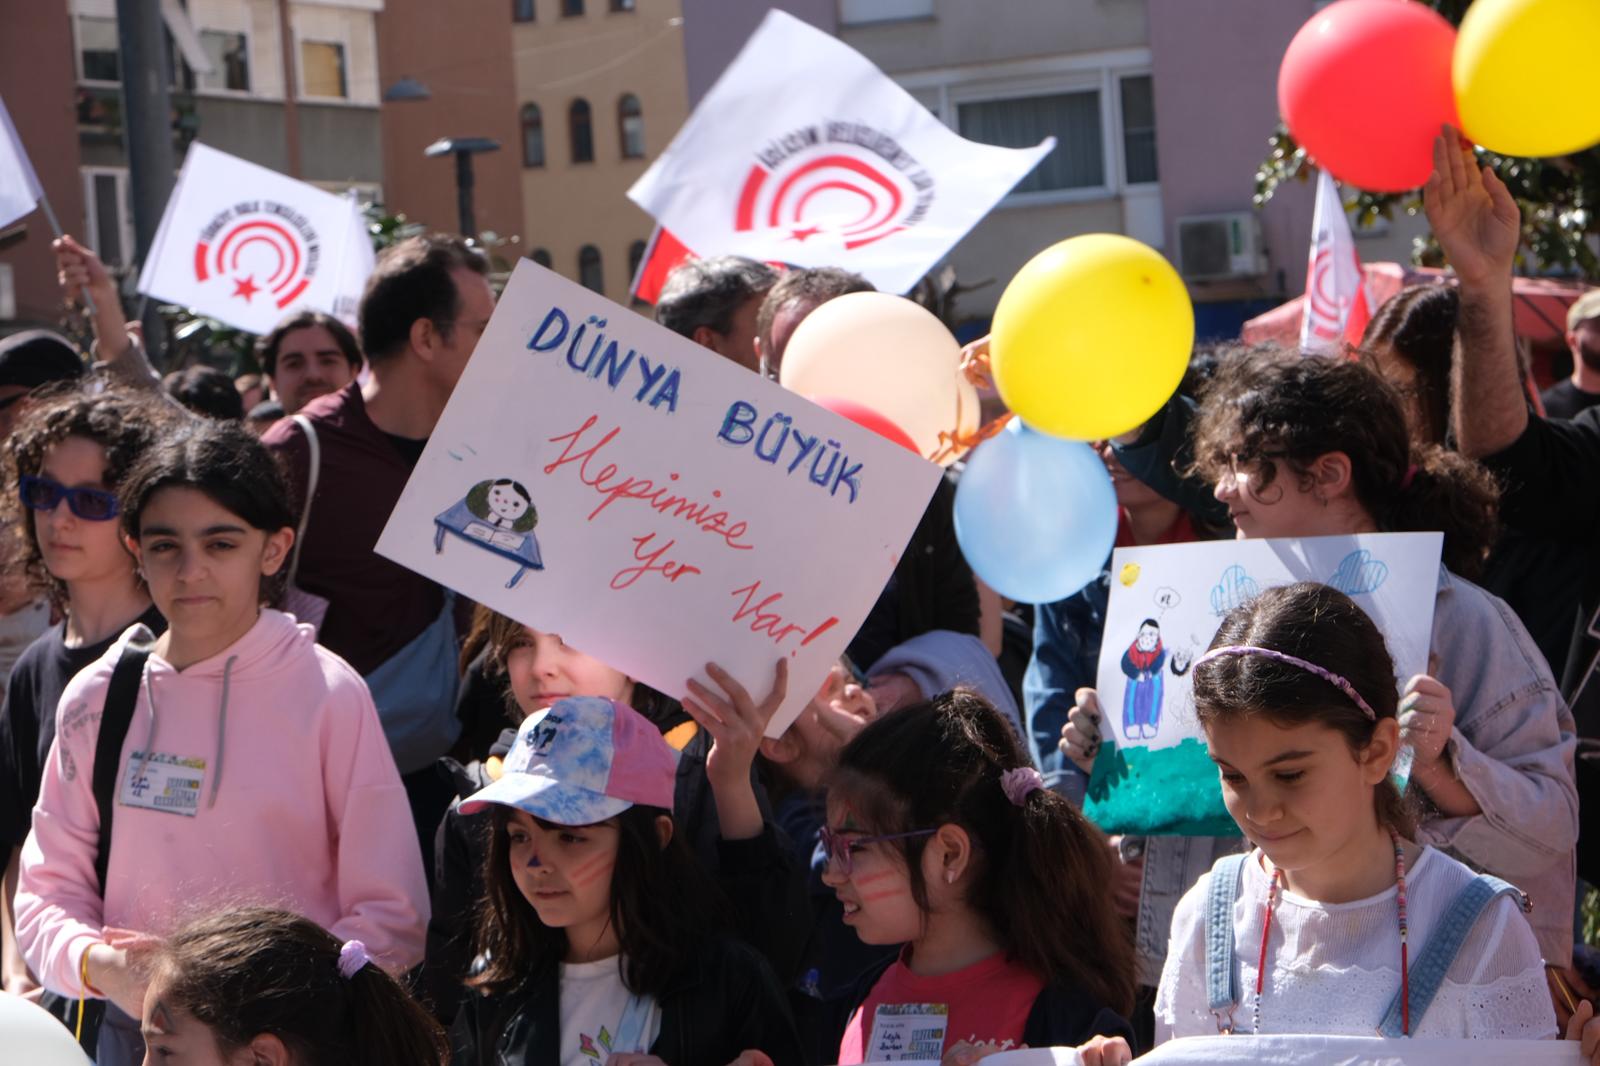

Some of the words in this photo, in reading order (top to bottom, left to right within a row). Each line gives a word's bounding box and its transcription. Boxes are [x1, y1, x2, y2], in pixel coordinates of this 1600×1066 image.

[526, 306, 682, 414] DÜNYA
[717, 400, 865, 505] BÜYÜK
[543, 414, 754, 551] Hepimize
[609, 531, 702, 591] Yer
[731, 580, 840, 658] Var!
